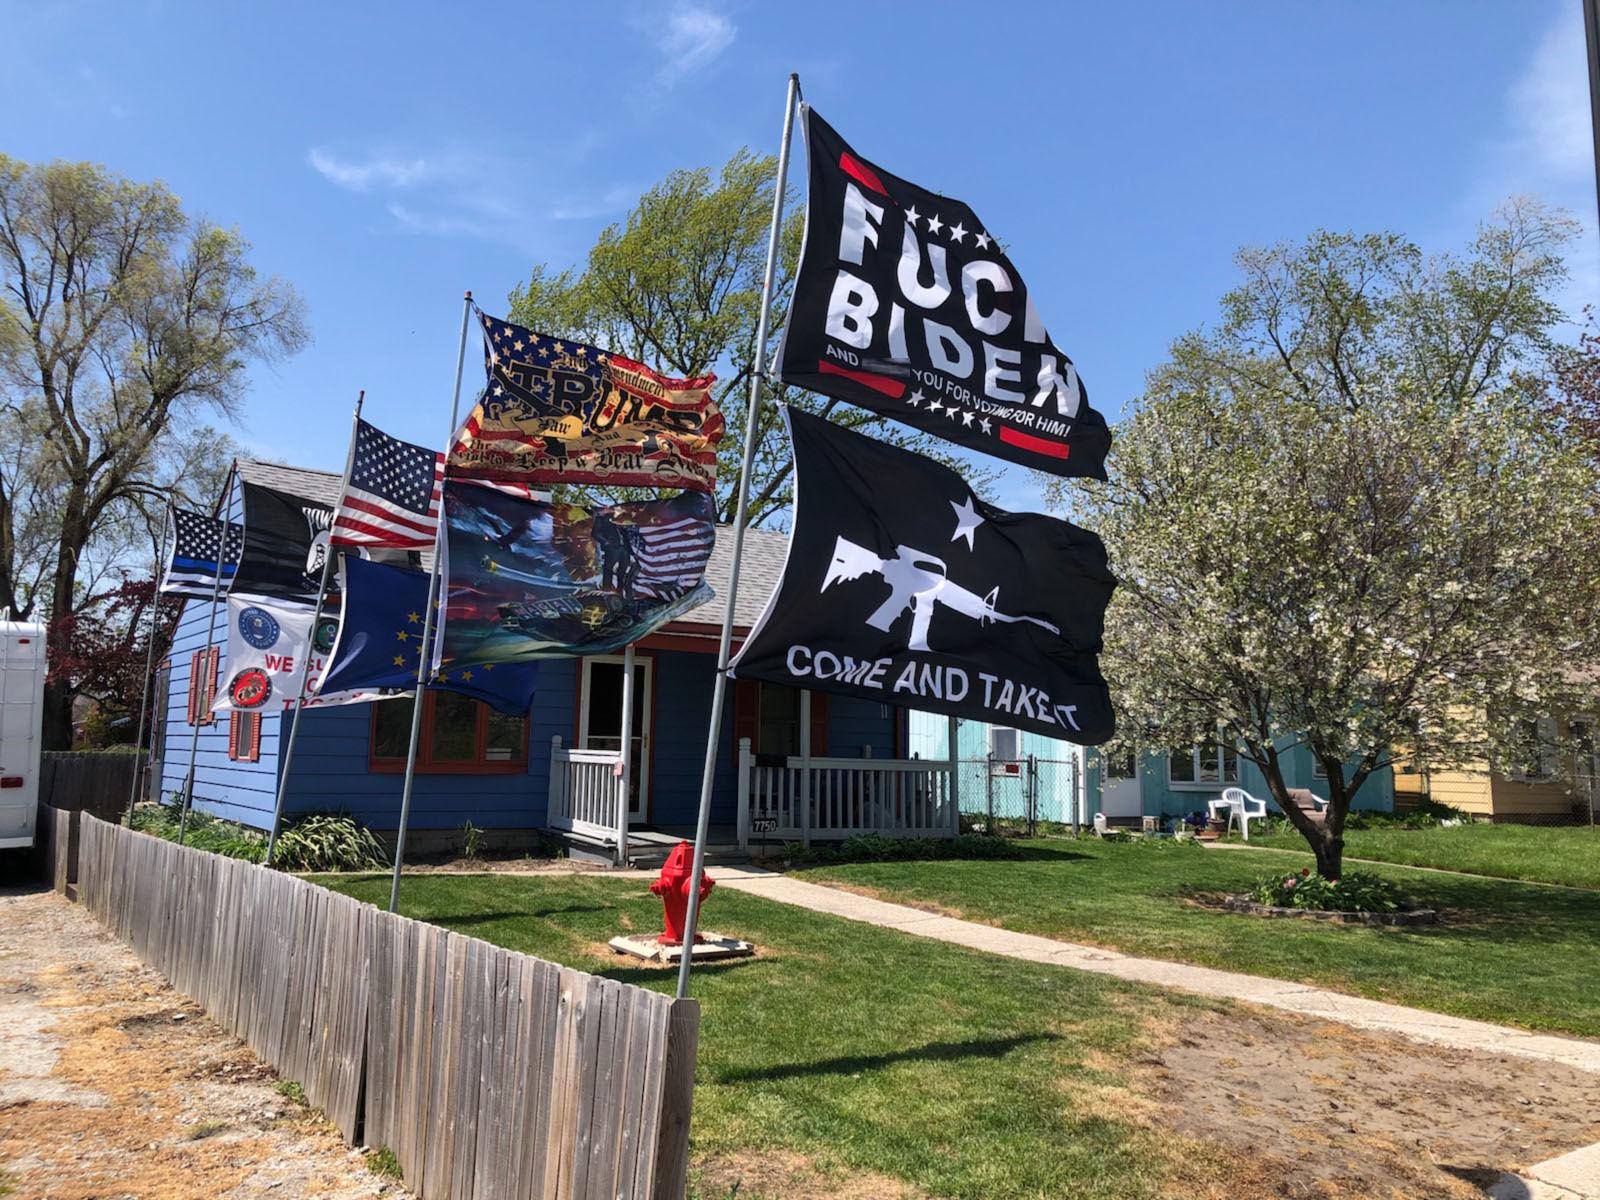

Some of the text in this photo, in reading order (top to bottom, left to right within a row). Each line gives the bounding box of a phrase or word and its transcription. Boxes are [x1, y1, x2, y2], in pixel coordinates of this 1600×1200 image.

[825, 270, 1081, 418] BIDEN
[826, 344, 1071, 438] AND YOU FOR VOTING FOR HIM!
[594, 446, 644, 474] Bear
[265, 654, 294, 673] WE
[786, 645, 1081, 731] COME AND TAKE IT
[754, 820, 776, 832] 7750
